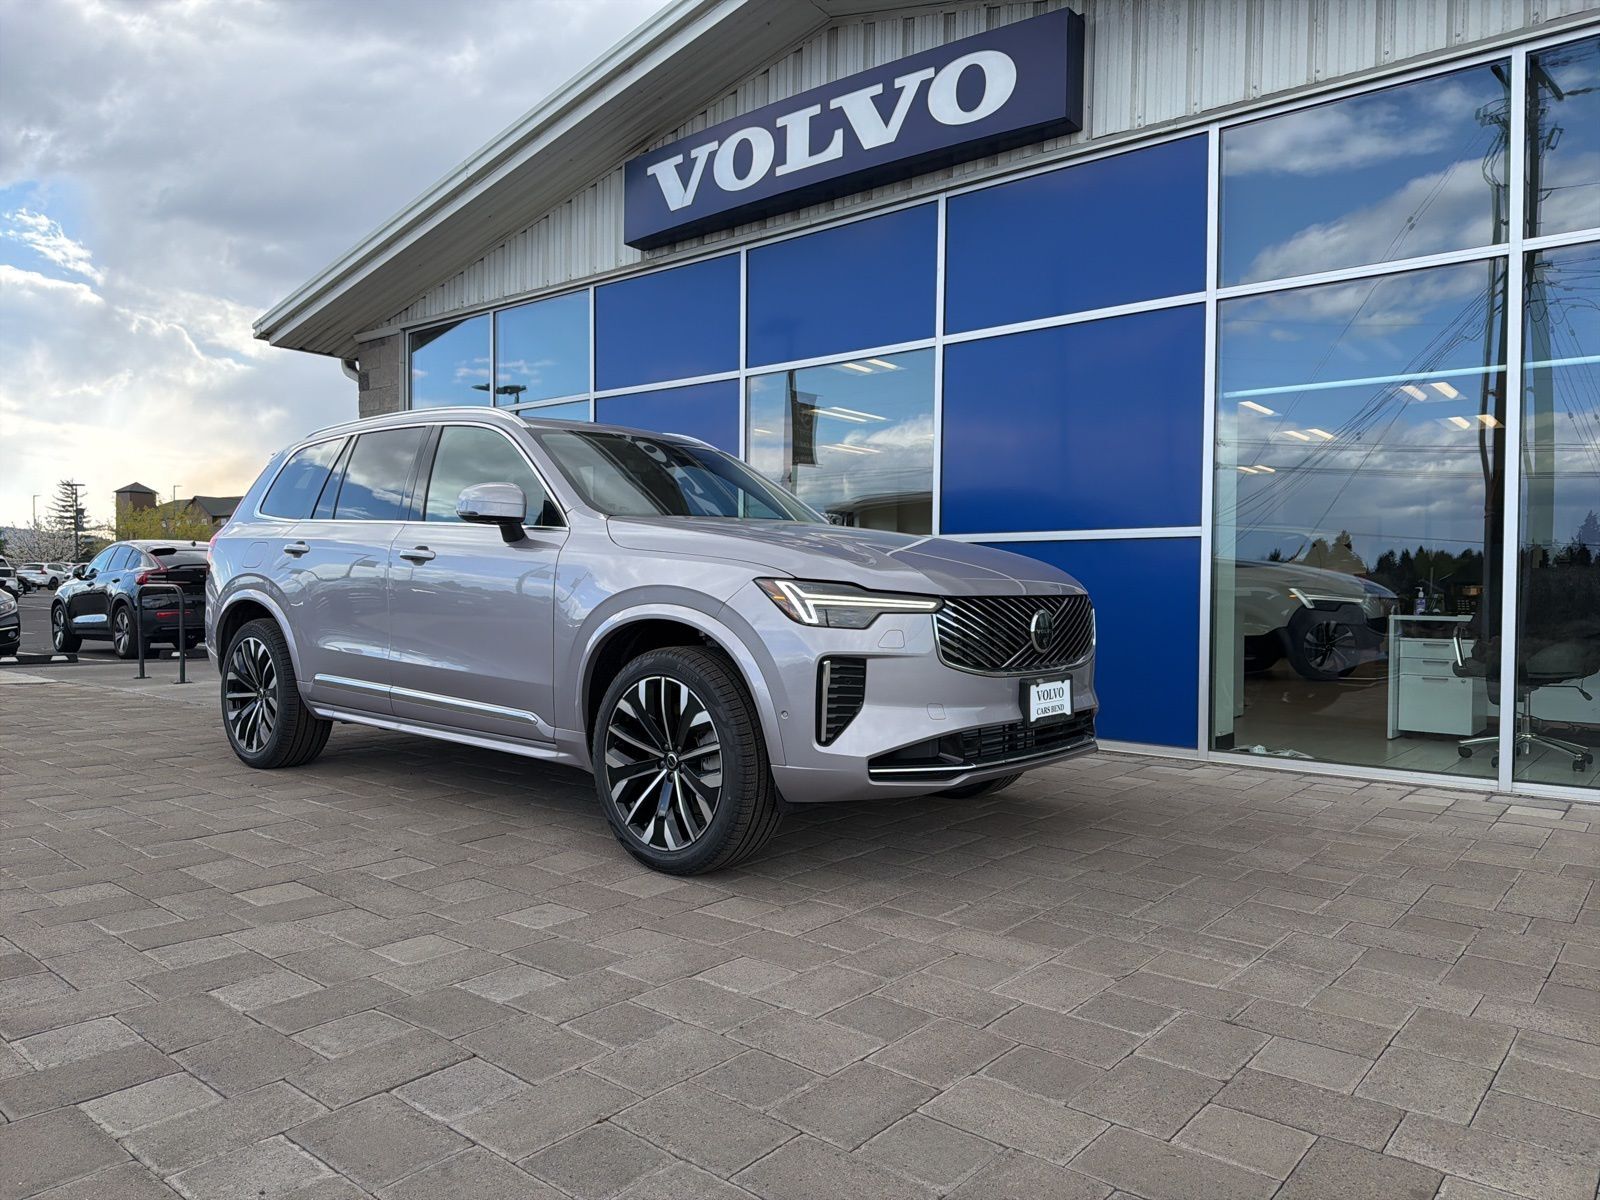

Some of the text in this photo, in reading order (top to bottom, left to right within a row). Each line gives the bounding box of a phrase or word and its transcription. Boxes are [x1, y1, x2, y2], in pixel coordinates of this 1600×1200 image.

[647, 49, 1017, 212] VOLVO
[1036, 687, 1064, 701] VOLVO
[1036, 704, 1064, 716] CARS BEND
